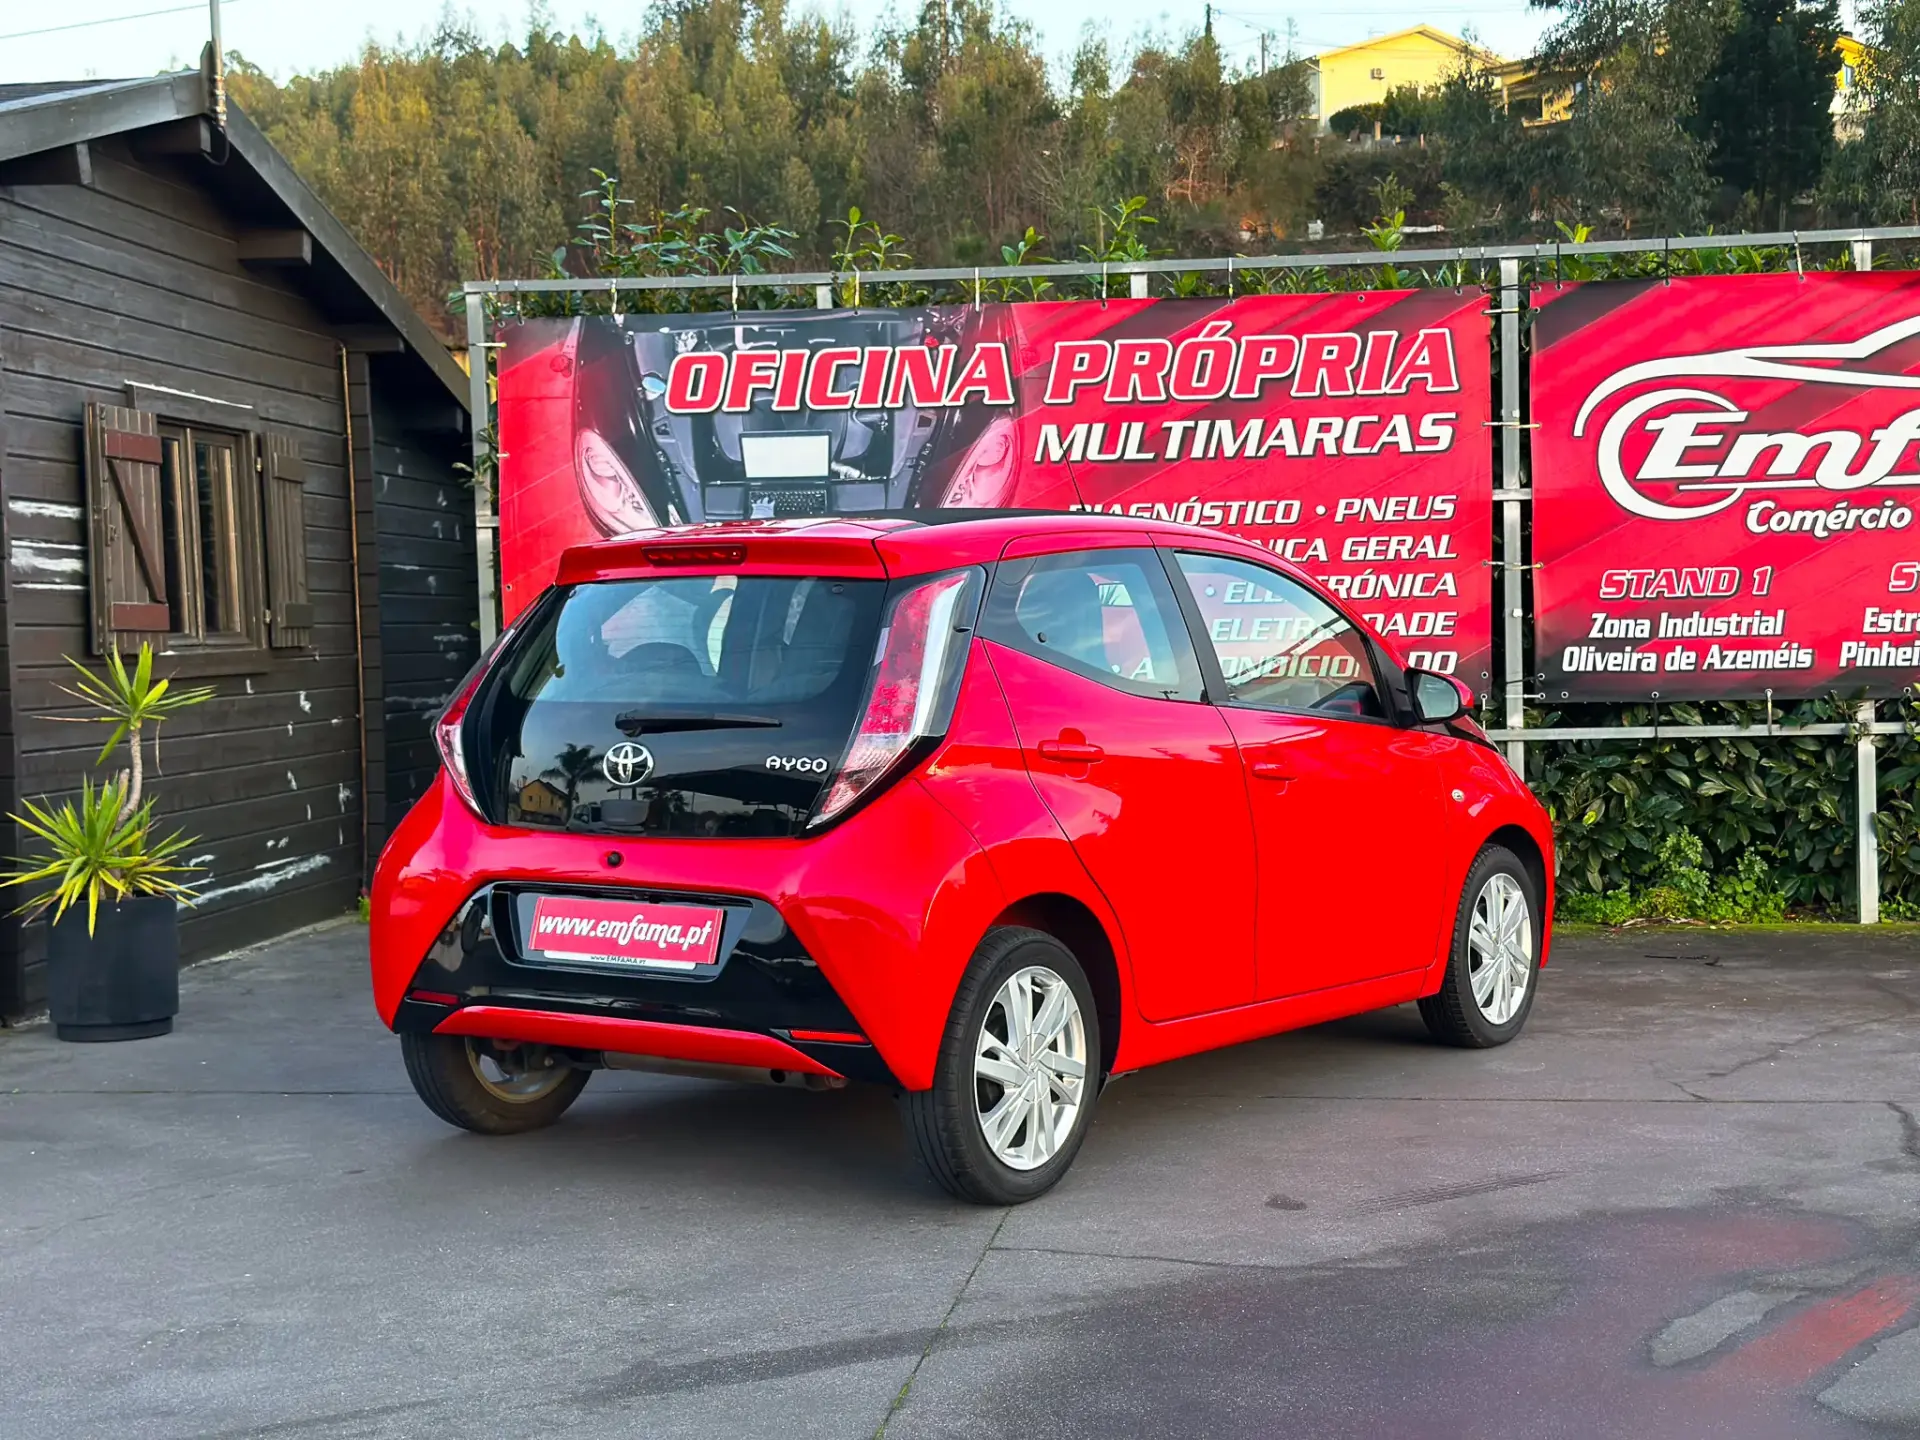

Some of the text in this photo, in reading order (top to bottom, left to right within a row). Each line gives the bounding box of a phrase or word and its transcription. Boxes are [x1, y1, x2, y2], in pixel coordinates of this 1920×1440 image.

[665, 320, 1459, 412] OFICINA PRÓPRIA
[1034, 412, 1456, 462] MULTIMARCAS
[1637, 408, 1920, 490] Emf
[1336, 496, 1456, 521] PNEUS
[1746, 500, 1912, 538] Comércio
[1342, 534, 1458, 561] GERAL
[1601, 566, 1773, 598] STAND 1
[1889, 562, 1920, 592] S
[1588, 609, 1785, 639] Zona Industrial
[1863, 607, 1920, 633] Estr
[1563, 643, 1812, 673] Oliveira de Azeméis
[766, 756, 828, 773] AYGO
[539, 915, 712, 950] www.emfama.pt
